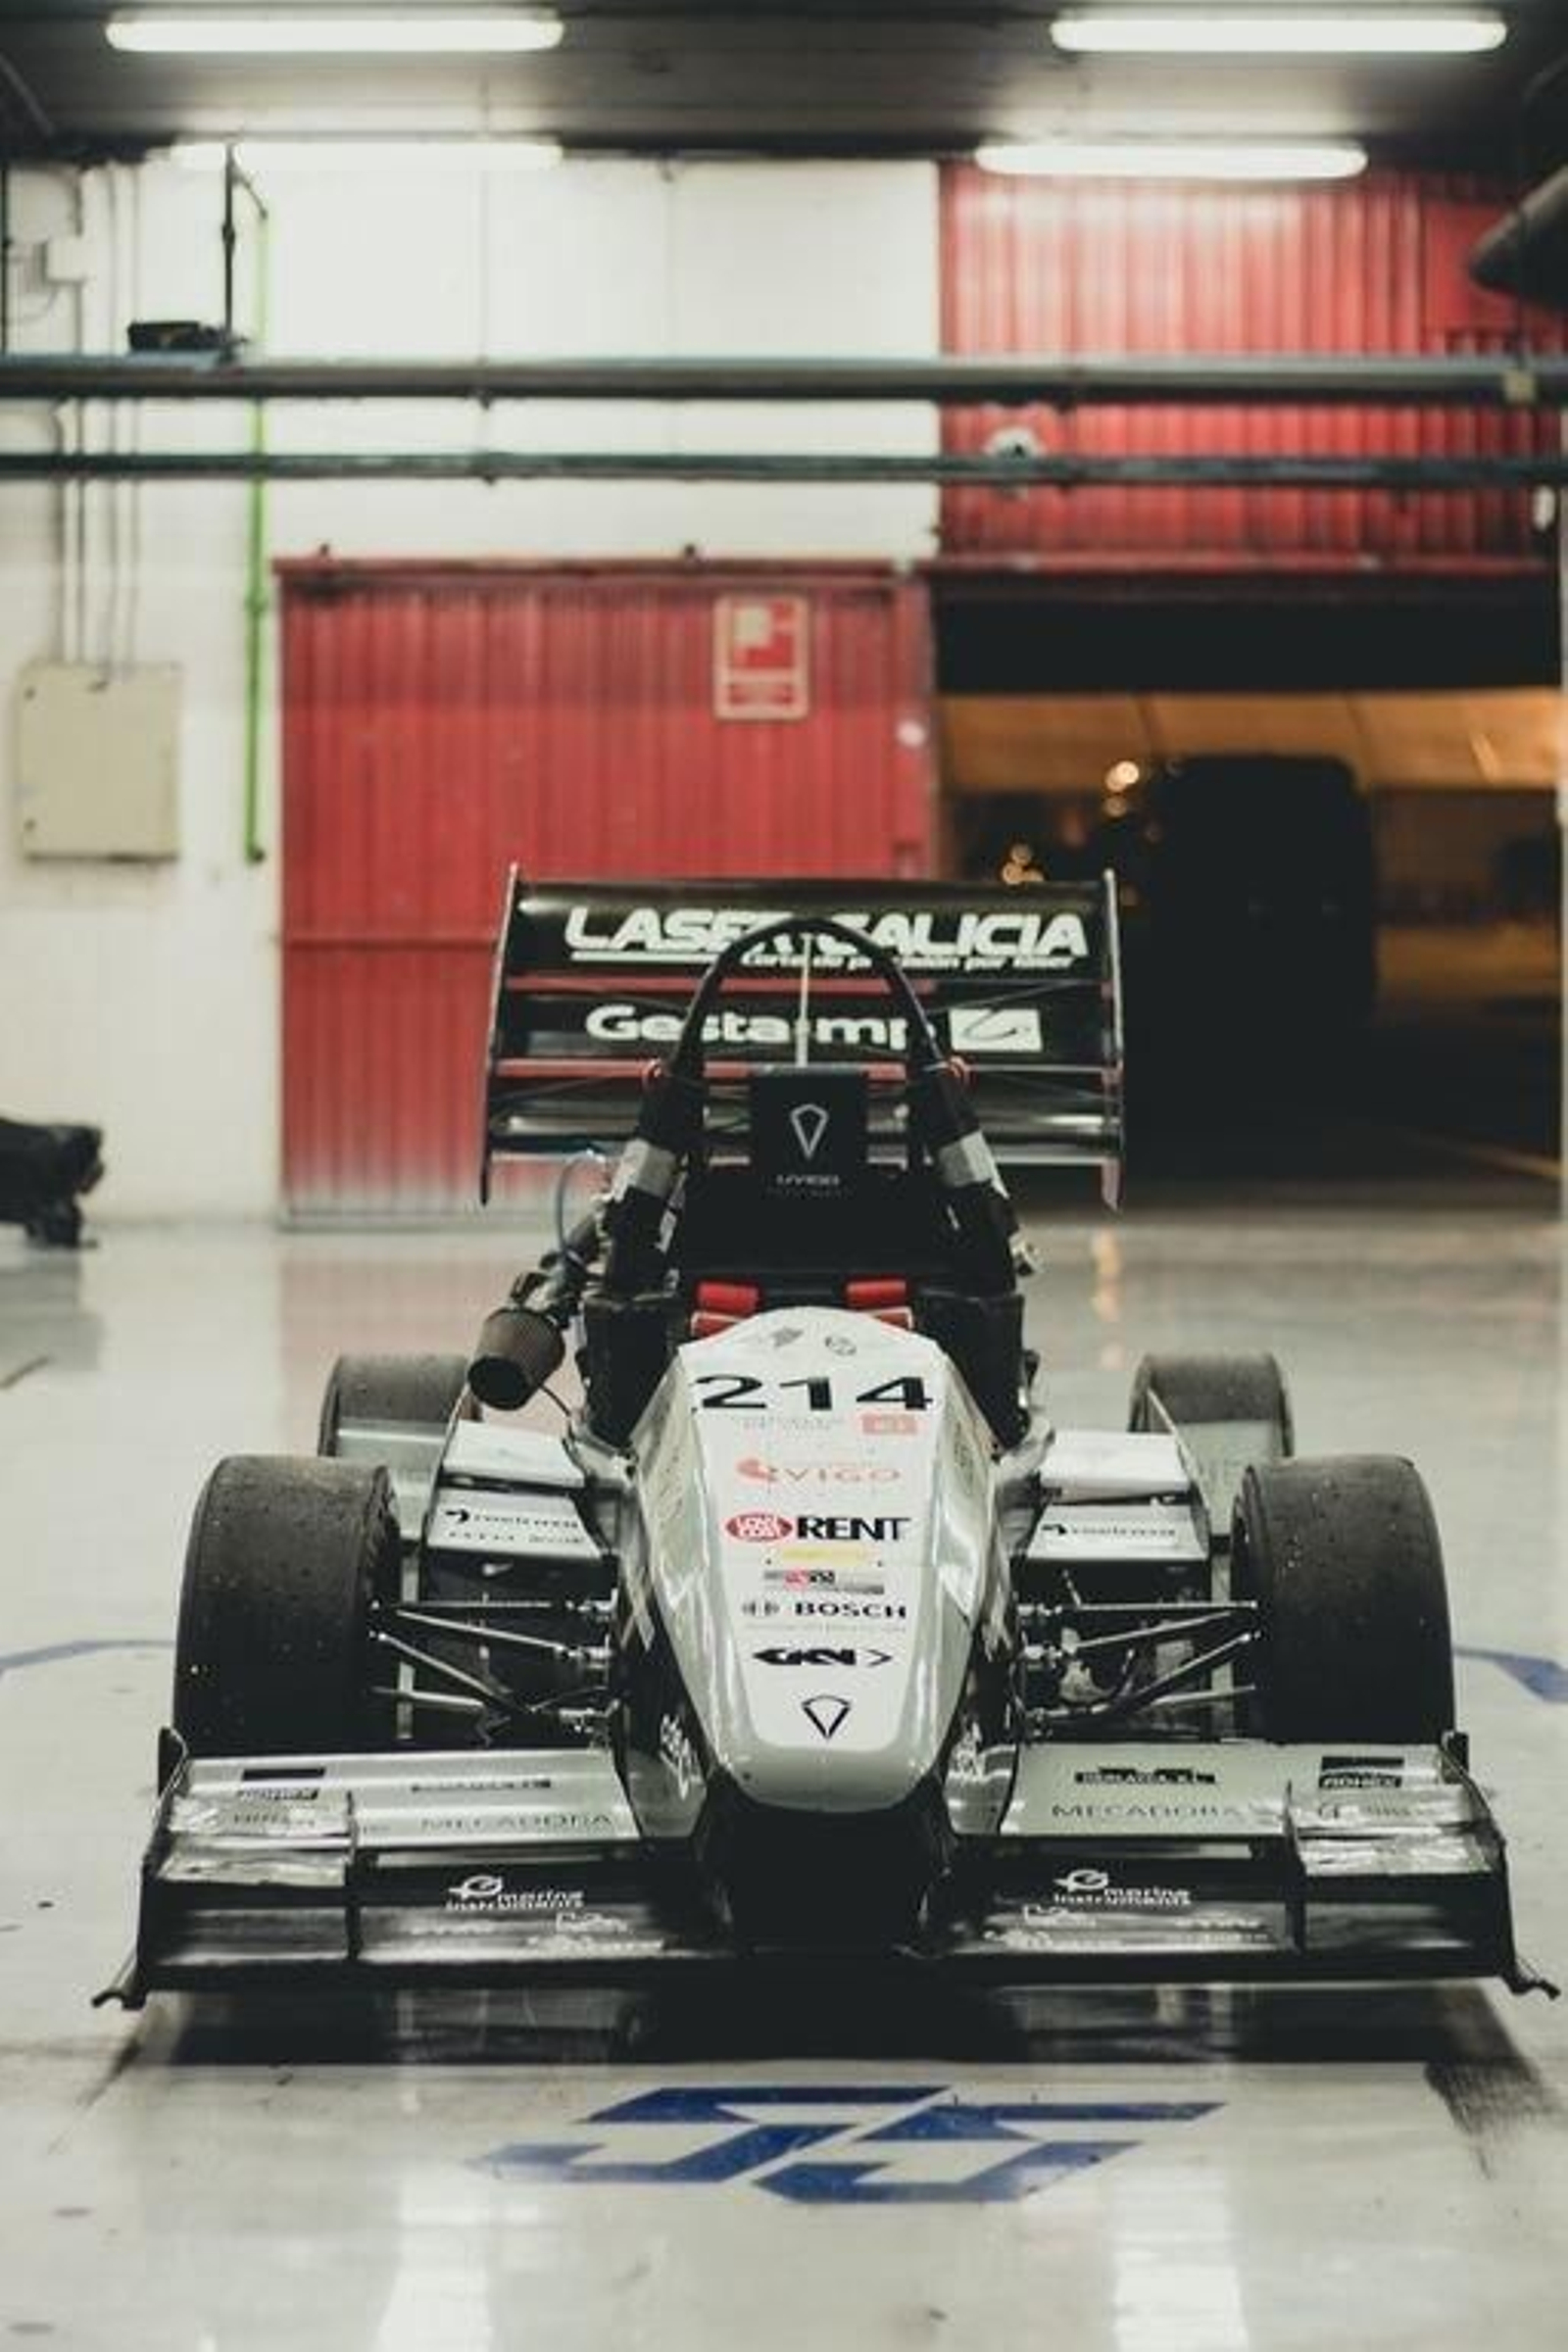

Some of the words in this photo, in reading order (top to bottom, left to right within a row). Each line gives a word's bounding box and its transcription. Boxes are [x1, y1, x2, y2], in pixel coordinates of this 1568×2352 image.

[694, 1375, 933, 1411] 214
[785, 1468, 902, 1483] VIGO
[796, 1516, 912, 1541] RENT
[795, 1601, 906, 1619] BOSCH
